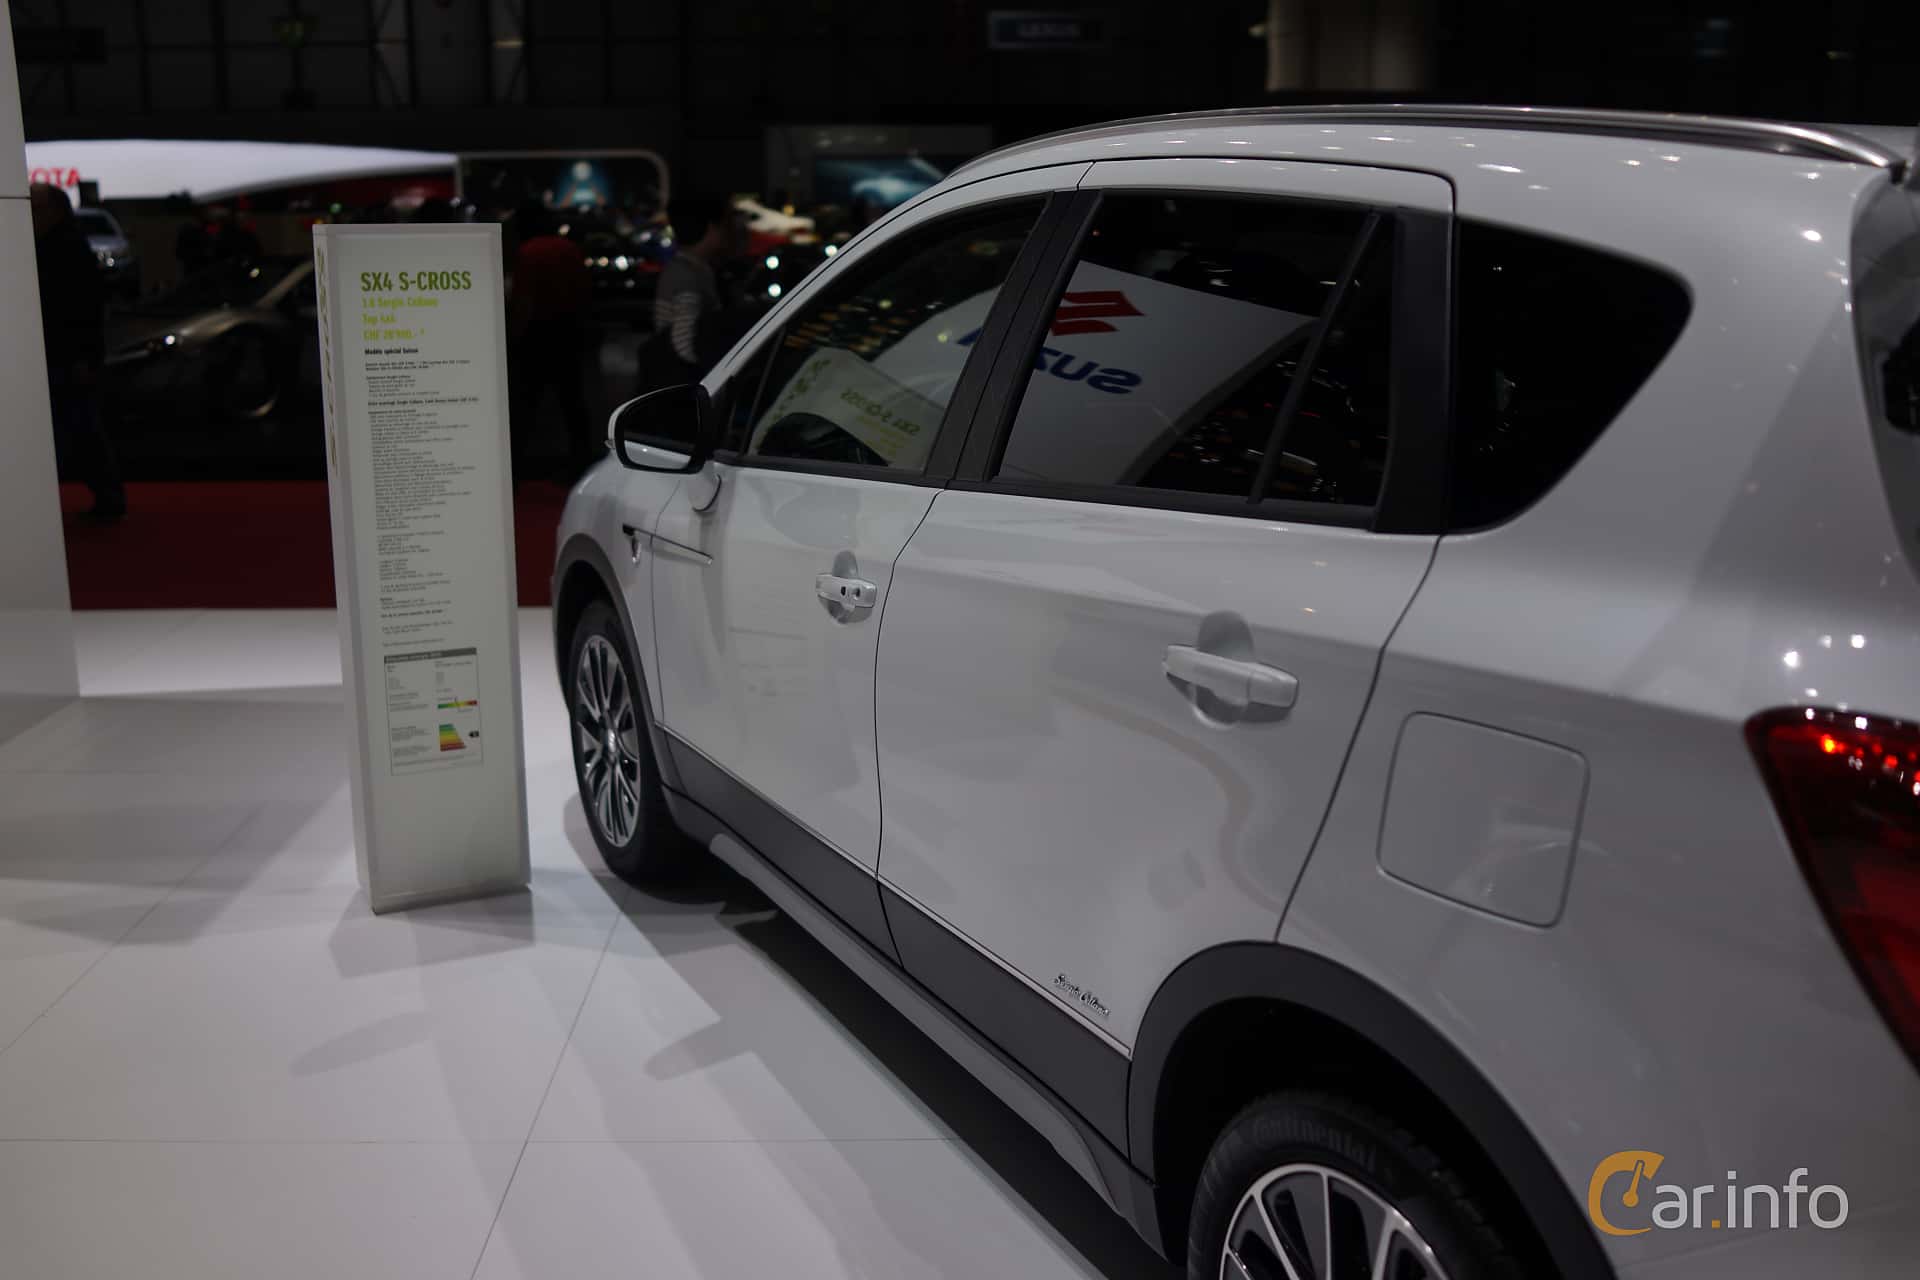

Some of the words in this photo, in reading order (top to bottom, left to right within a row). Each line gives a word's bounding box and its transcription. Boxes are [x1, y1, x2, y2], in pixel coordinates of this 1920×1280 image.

[31, 168, 79, 188] OTA
[361, 271, 393, 292] SX4
[399, 270, 472, 291] S-CROSS
[1251, 1114, 1377, 1175] Continental
